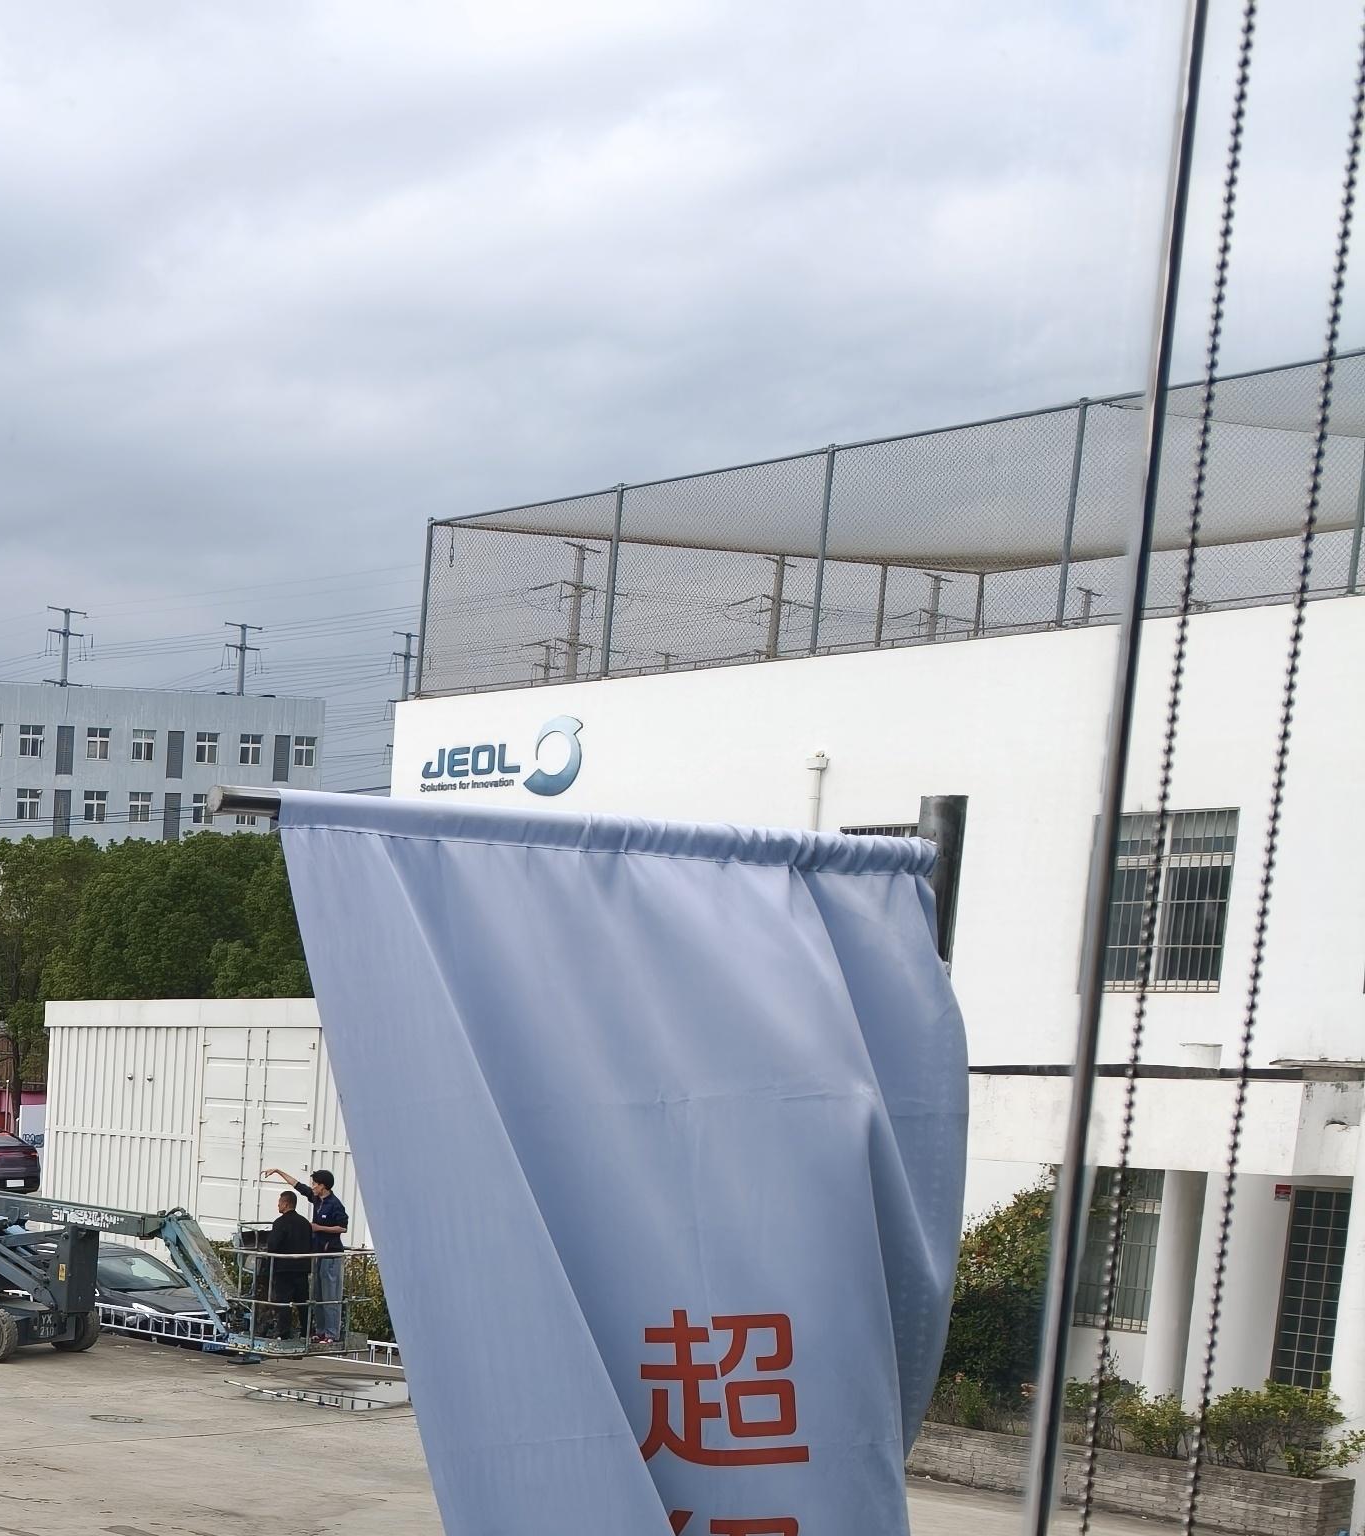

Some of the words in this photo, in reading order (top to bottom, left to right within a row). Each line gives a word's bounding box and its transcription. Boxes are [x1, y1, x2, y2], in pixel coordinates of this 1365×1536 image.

[421, 743, 521, 779] JEOL
[419, 782, 457, 793] Solutions
[458, 780, 471, 791] for
[471, 777, 515, 790] Innovation
